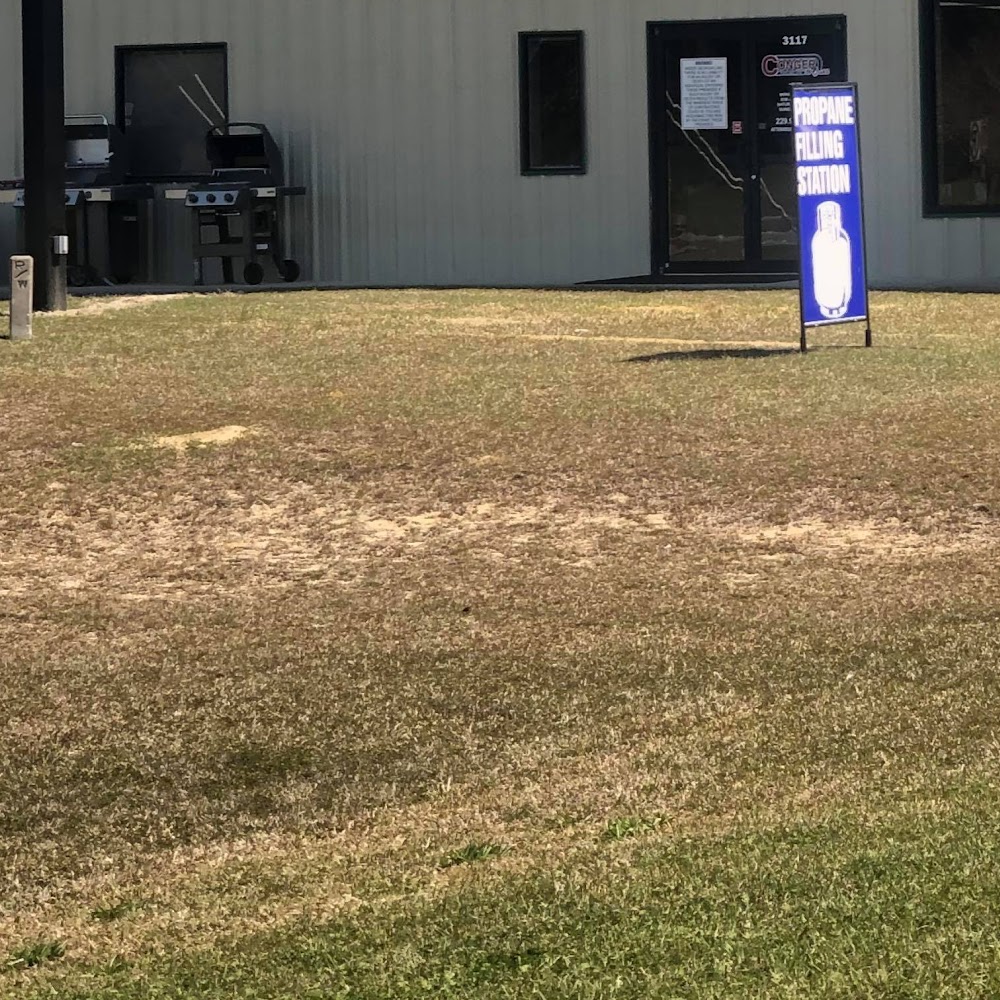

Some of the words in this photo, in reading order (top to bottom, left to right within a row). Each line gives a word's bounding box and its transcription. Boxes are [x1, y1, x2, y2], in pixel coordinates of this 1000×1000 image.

[782, 35, 808, 46] 3117
[793, 95, 855, 127] PROPANE
[795, 130, 845, 162] FILLING
[797, 164, 851, 196] STATION
